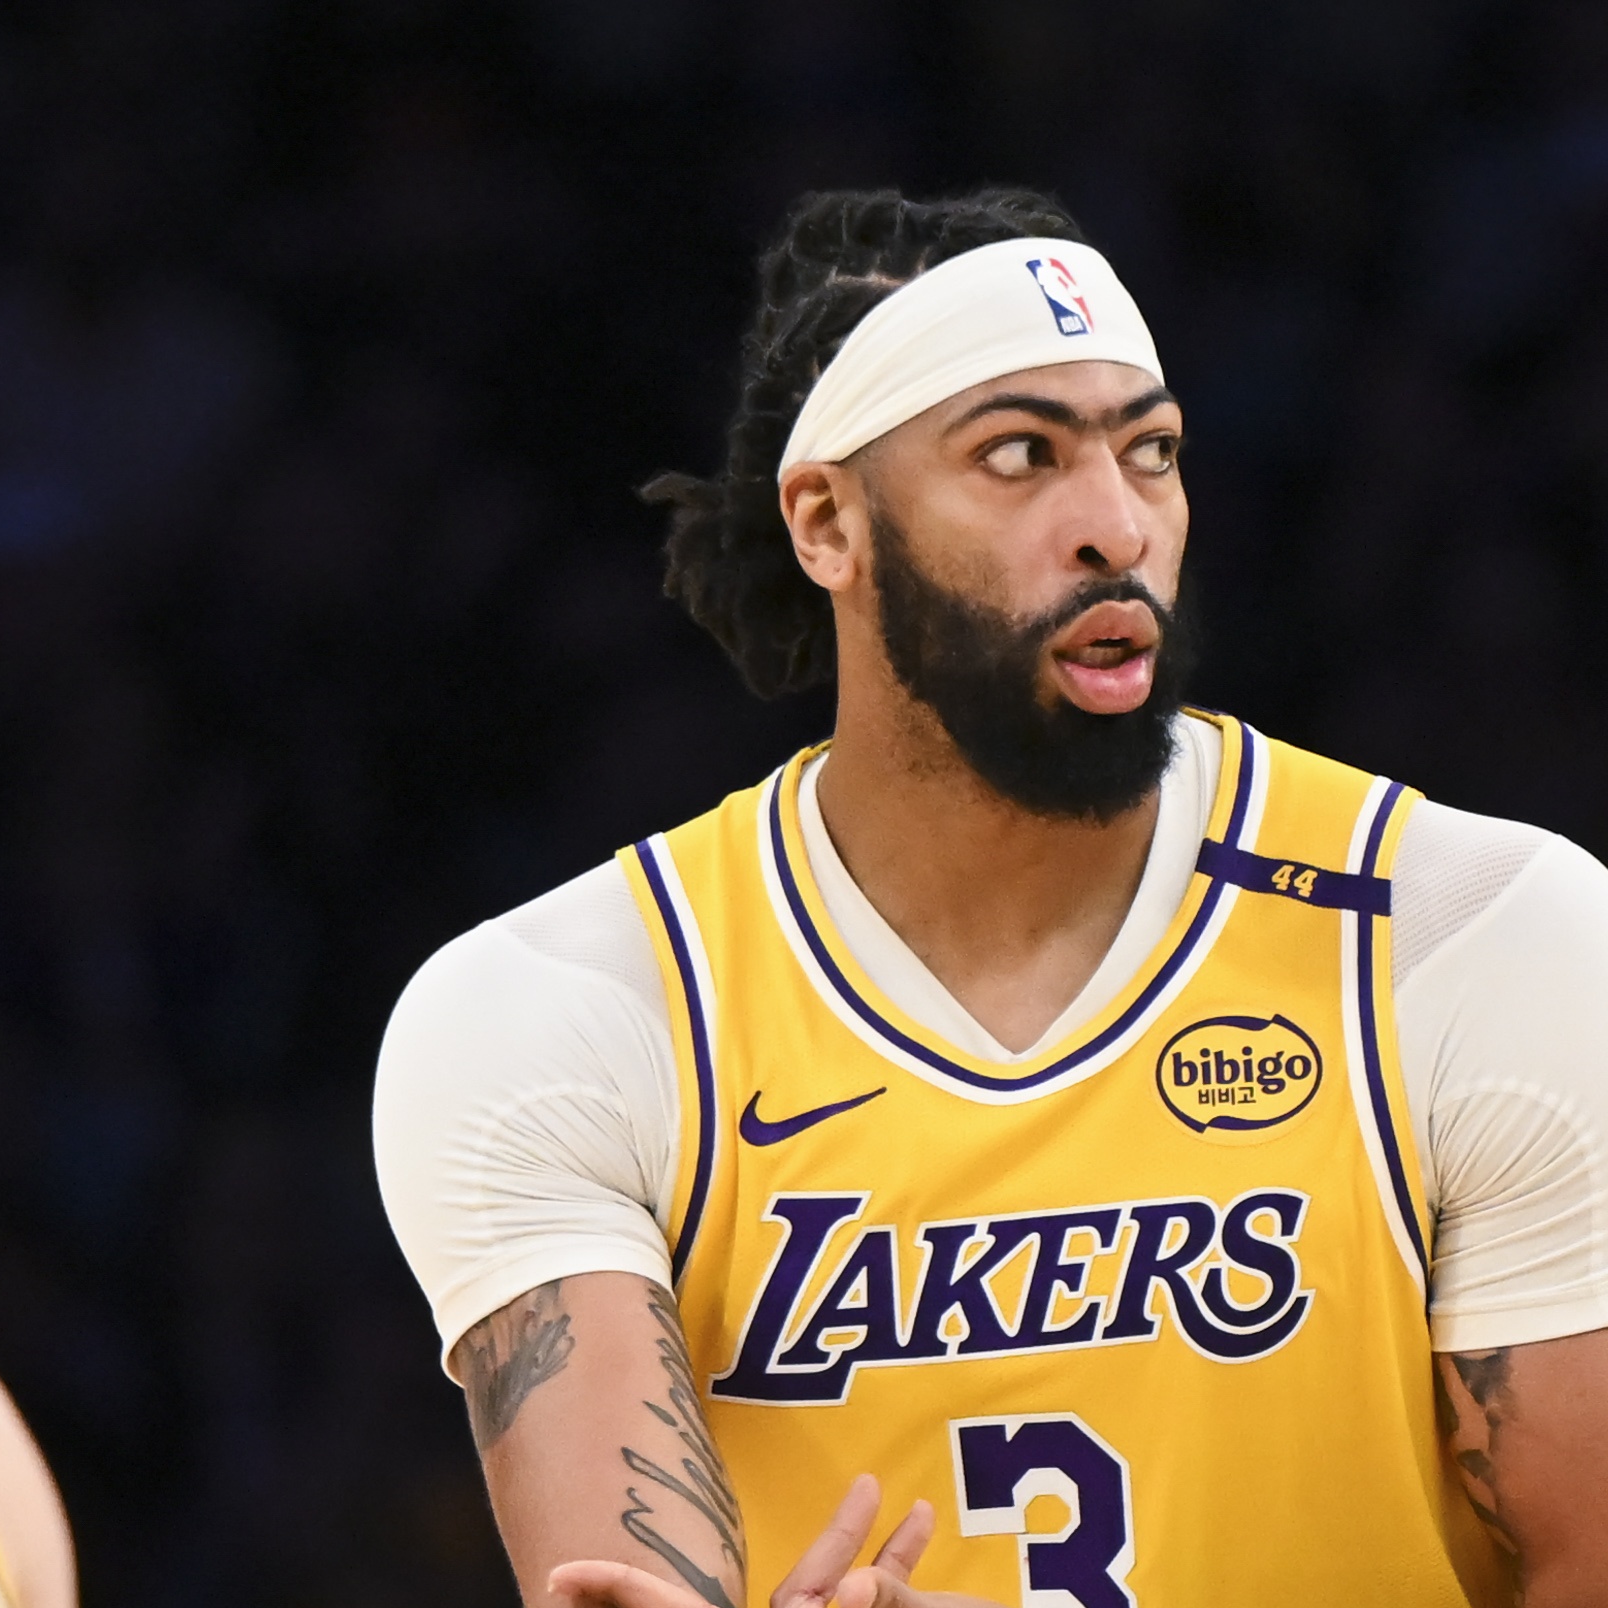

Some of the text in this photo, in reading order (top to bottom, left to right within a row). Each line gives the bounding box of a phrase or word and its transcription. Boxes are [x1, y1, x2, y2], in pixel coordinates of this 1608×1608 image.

[1271, 864, 1318, 898] 44
[1172, 1046, 1312, 1095] bibigo
[1197, 1086, 1257, 1108] 비비고
[709, 1187, 1314, 1405] LAKERS
